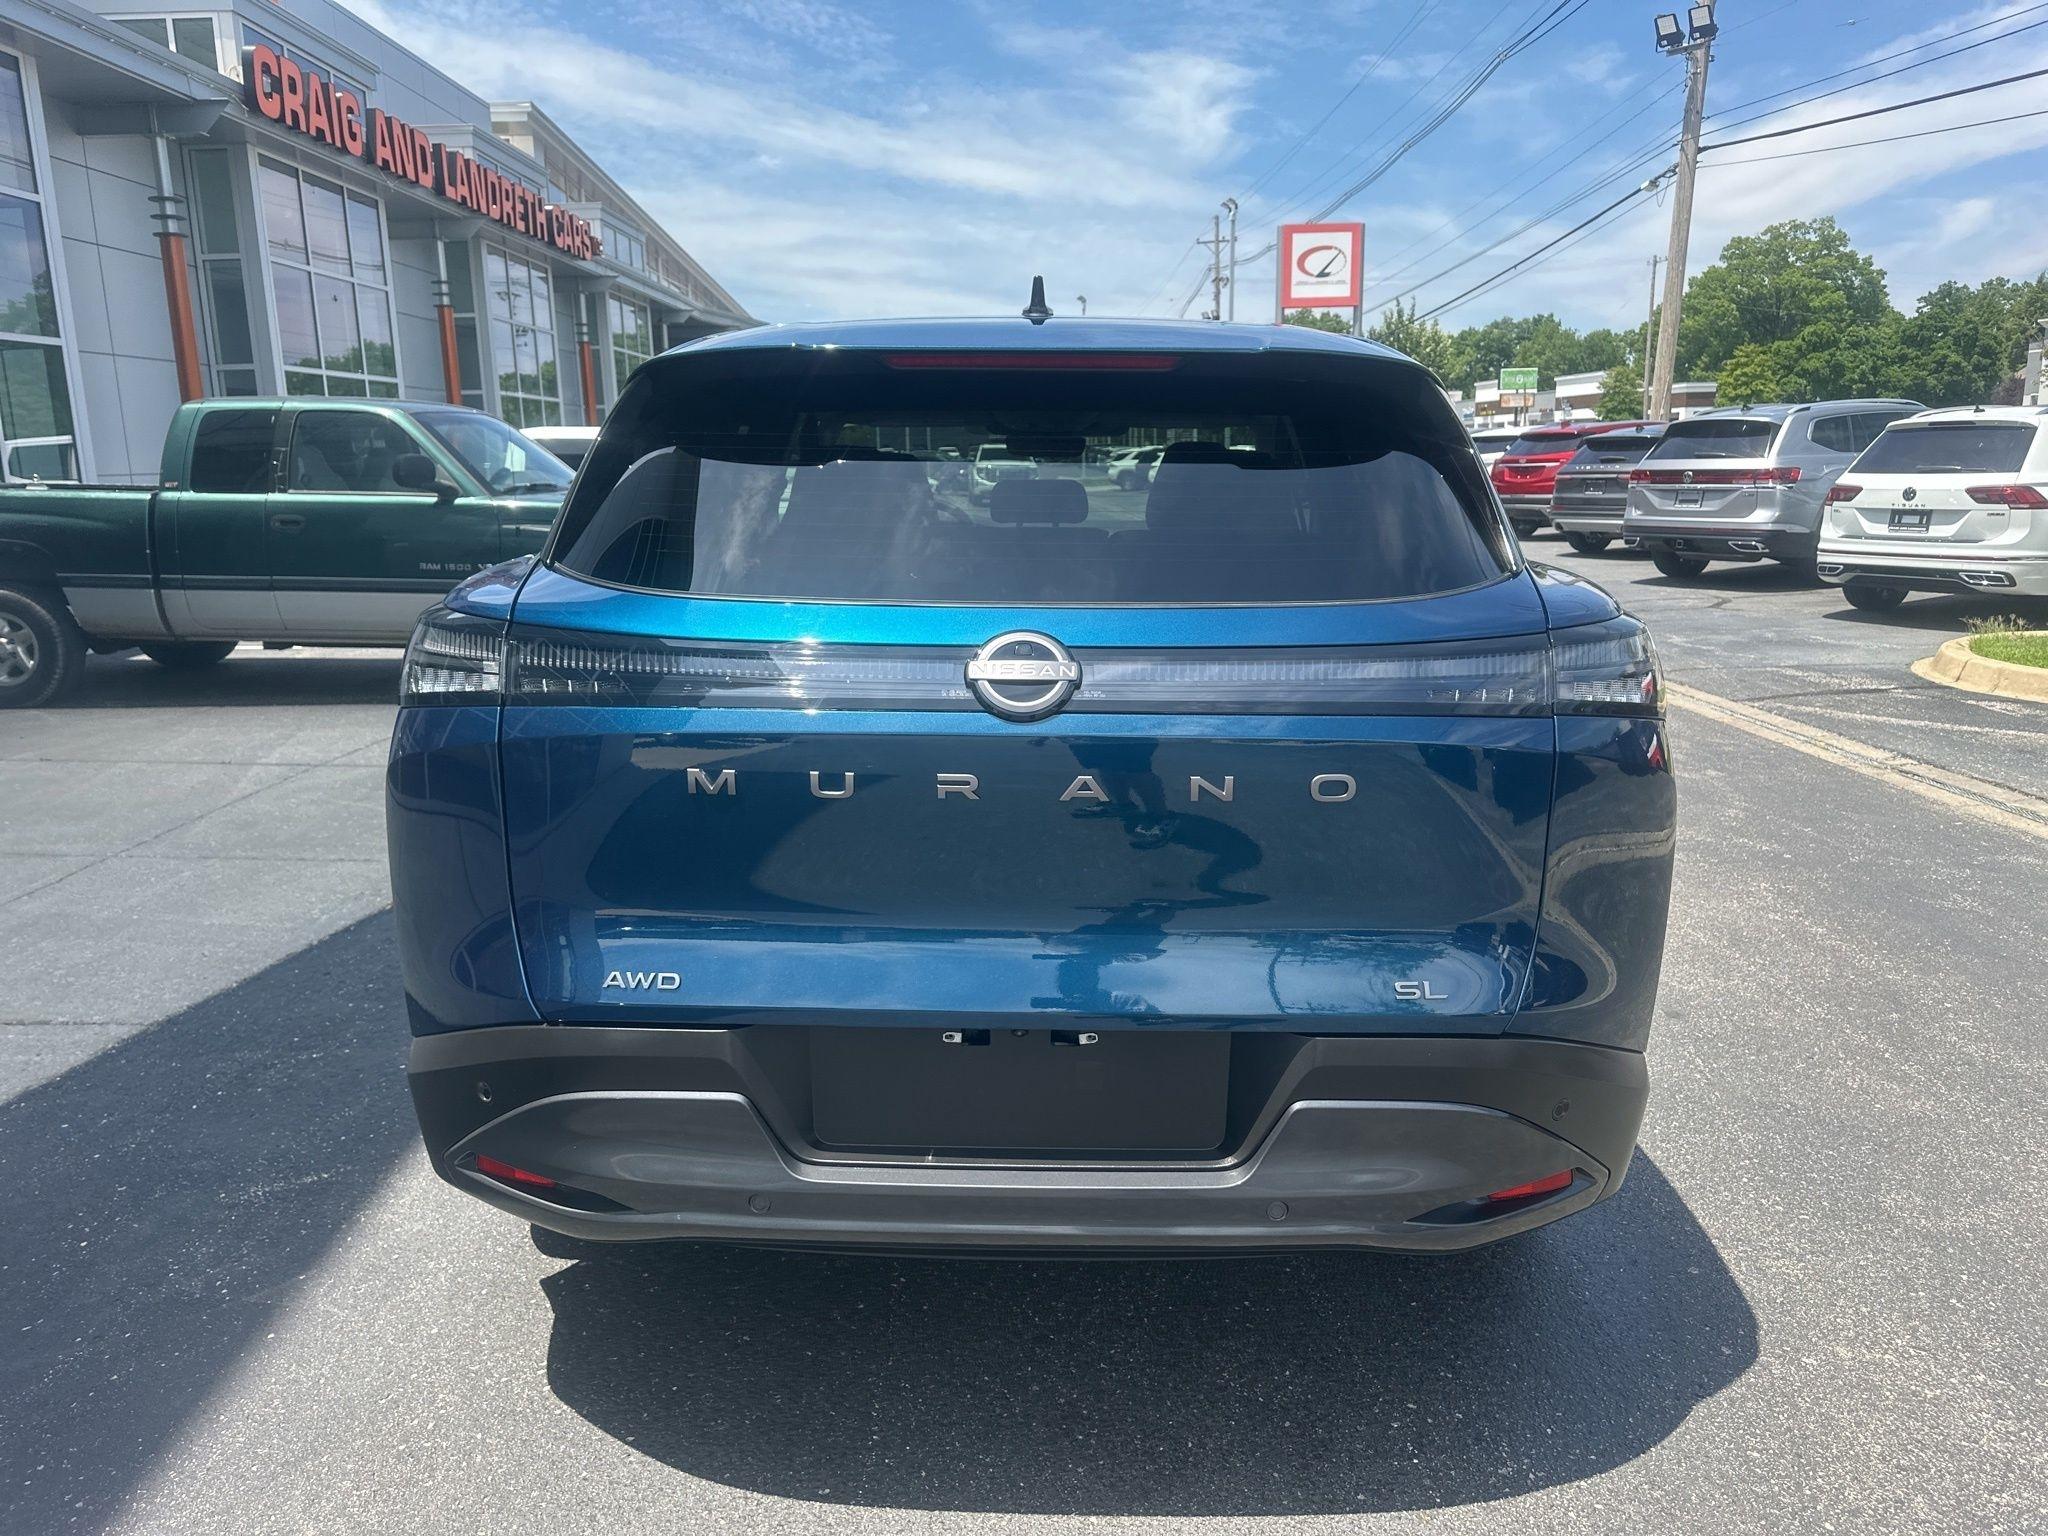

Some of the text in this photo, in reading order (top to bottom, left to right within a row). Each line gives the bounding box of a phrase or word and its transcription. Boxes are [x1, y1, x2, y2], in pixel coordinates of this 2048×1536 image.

[252, 44, 593, 261] CRAIG AND LANDRETH CARS
[419, 562, 441, 571] RAM
[445, 563, 472, 571] 1500
[972, 663, 1076, 677] NISSAN
[686, 767, 1358, 802] MURANO
[602, 971, 681, 990] AWD
[1394, 980, 1449, 1000] SL
